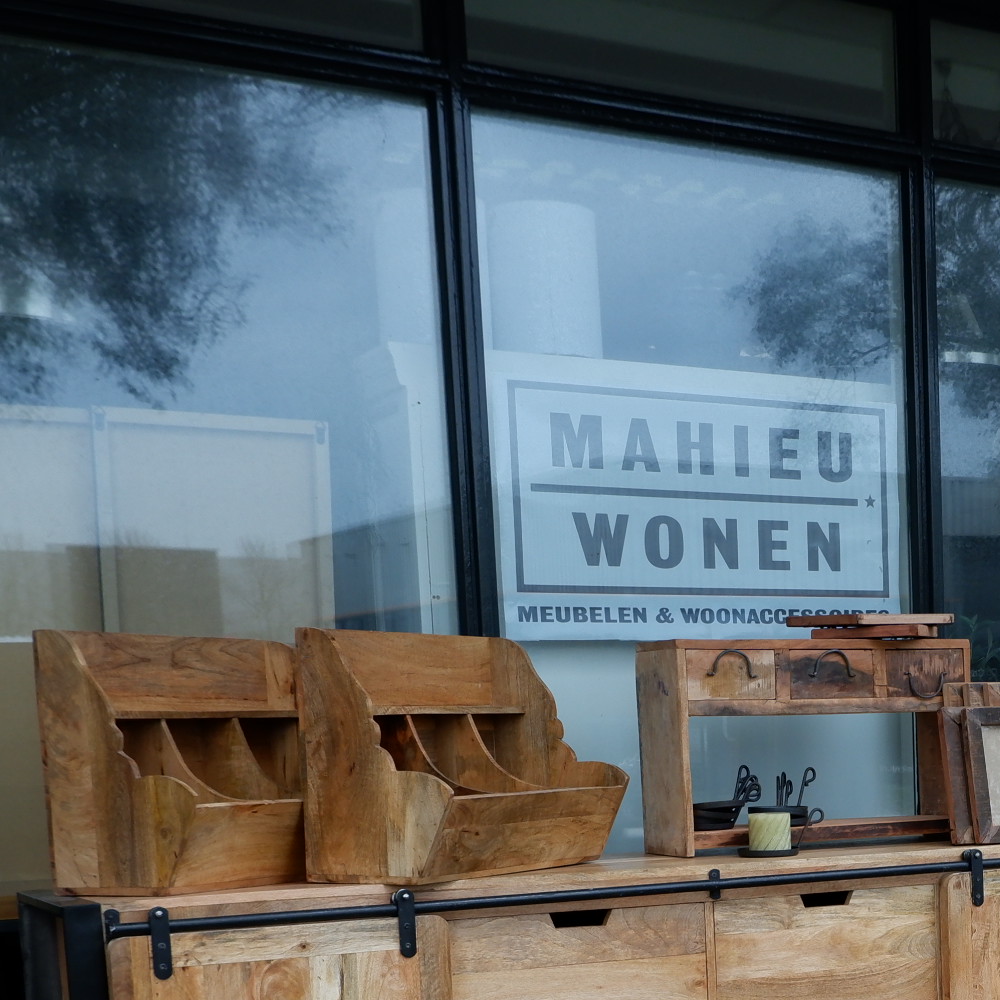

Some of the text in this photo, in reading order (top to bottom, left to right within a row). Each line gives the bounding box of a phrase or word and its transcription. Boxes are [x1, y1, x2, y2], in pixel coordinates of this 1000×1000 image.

[549, 411, 853, 483] MAHIEU
[571, 511, 842, 572] WONEN
[518, 605, 890, 625] MEUBELEN & WOONACCE
